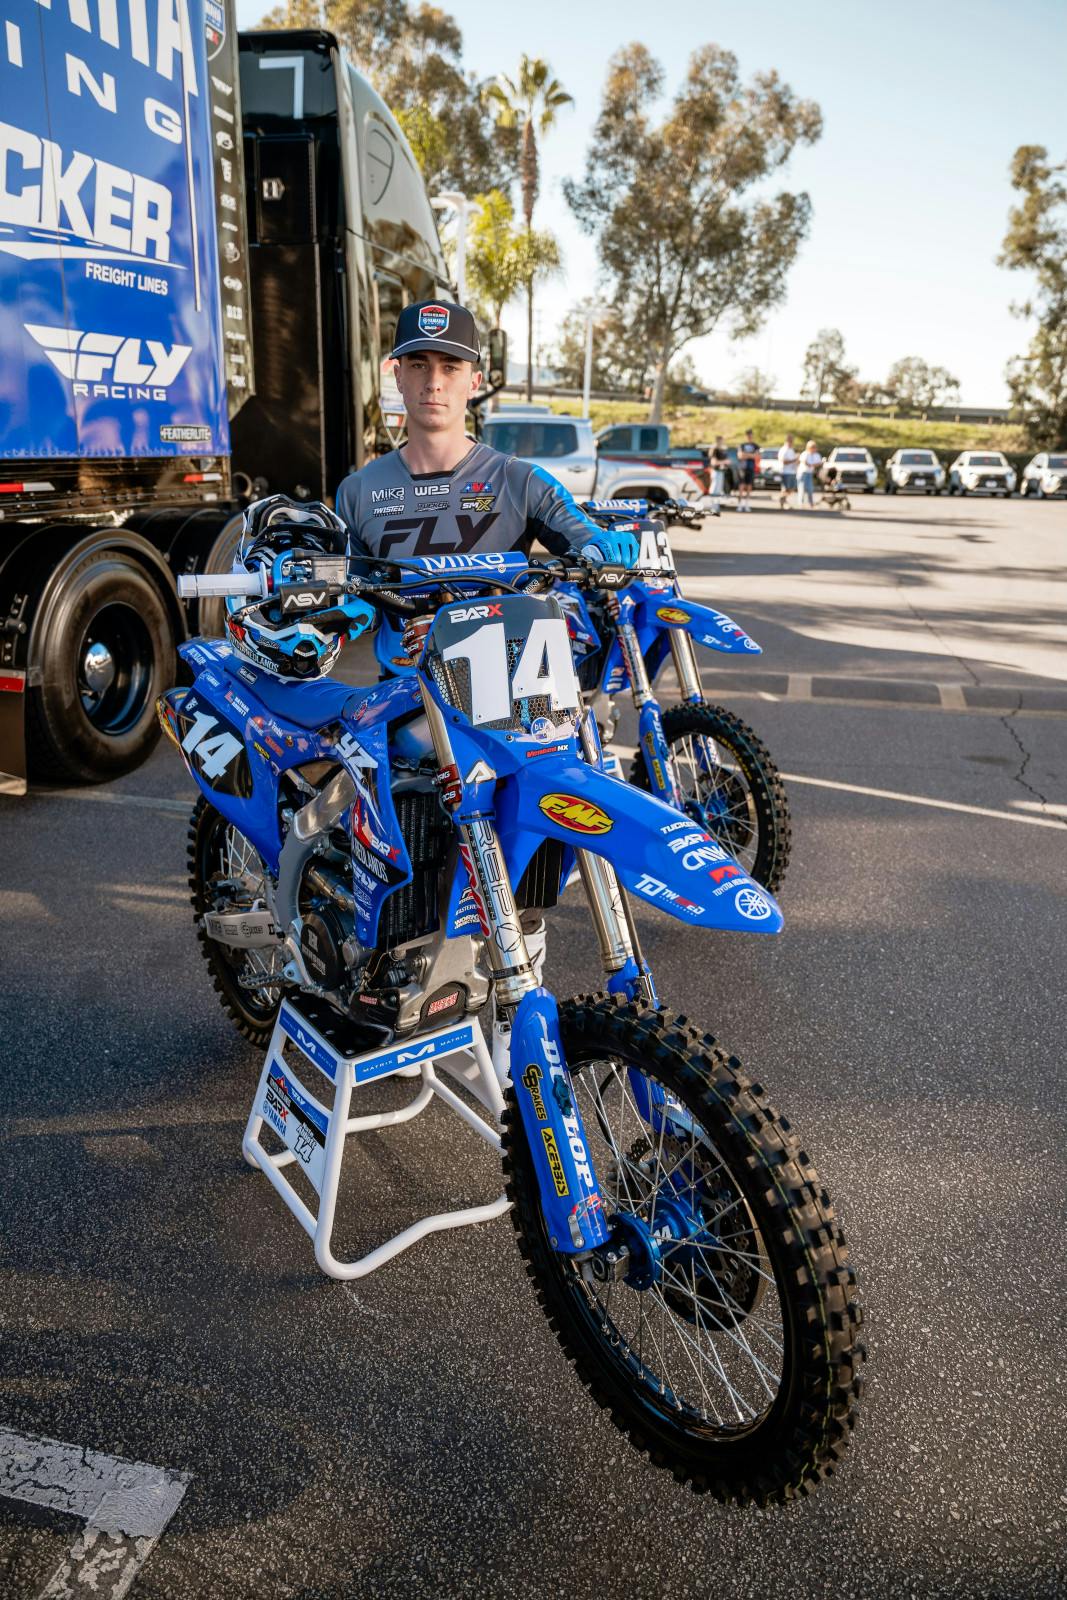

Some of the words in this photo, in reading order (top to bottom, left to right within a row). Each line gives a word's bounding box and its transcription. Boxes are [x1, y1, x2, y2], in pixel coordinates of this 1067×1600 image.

[85, 262, 135, 289] FREIGHT
[138, 275, 168, 296] LINES
[75, 331, 193, 387] FLY
[73, 383, 167, 401] RACING
[161, 427, 211, 441] FEATHERLITE
[415, 484, 450, 497] WPS
[378, 512, 501, 557] FLY
[639, 531, 675, 570] 43
[599, 573, 625, 583] ASV
[284, 592, 326, 609] ASV
[448, 603, 504, 624] BARX
[442, 618, 580, 726] 14
[181, 710, 245, 779] 14
[539, 795, 614, 830] FMF
[266, 1088, 289, 1121] BARX
[540, 1037, 594, 1188] DULOP
[293, 1135, 316, 1164] 14
[541, 1130, 568, 1195] ACERBIS
